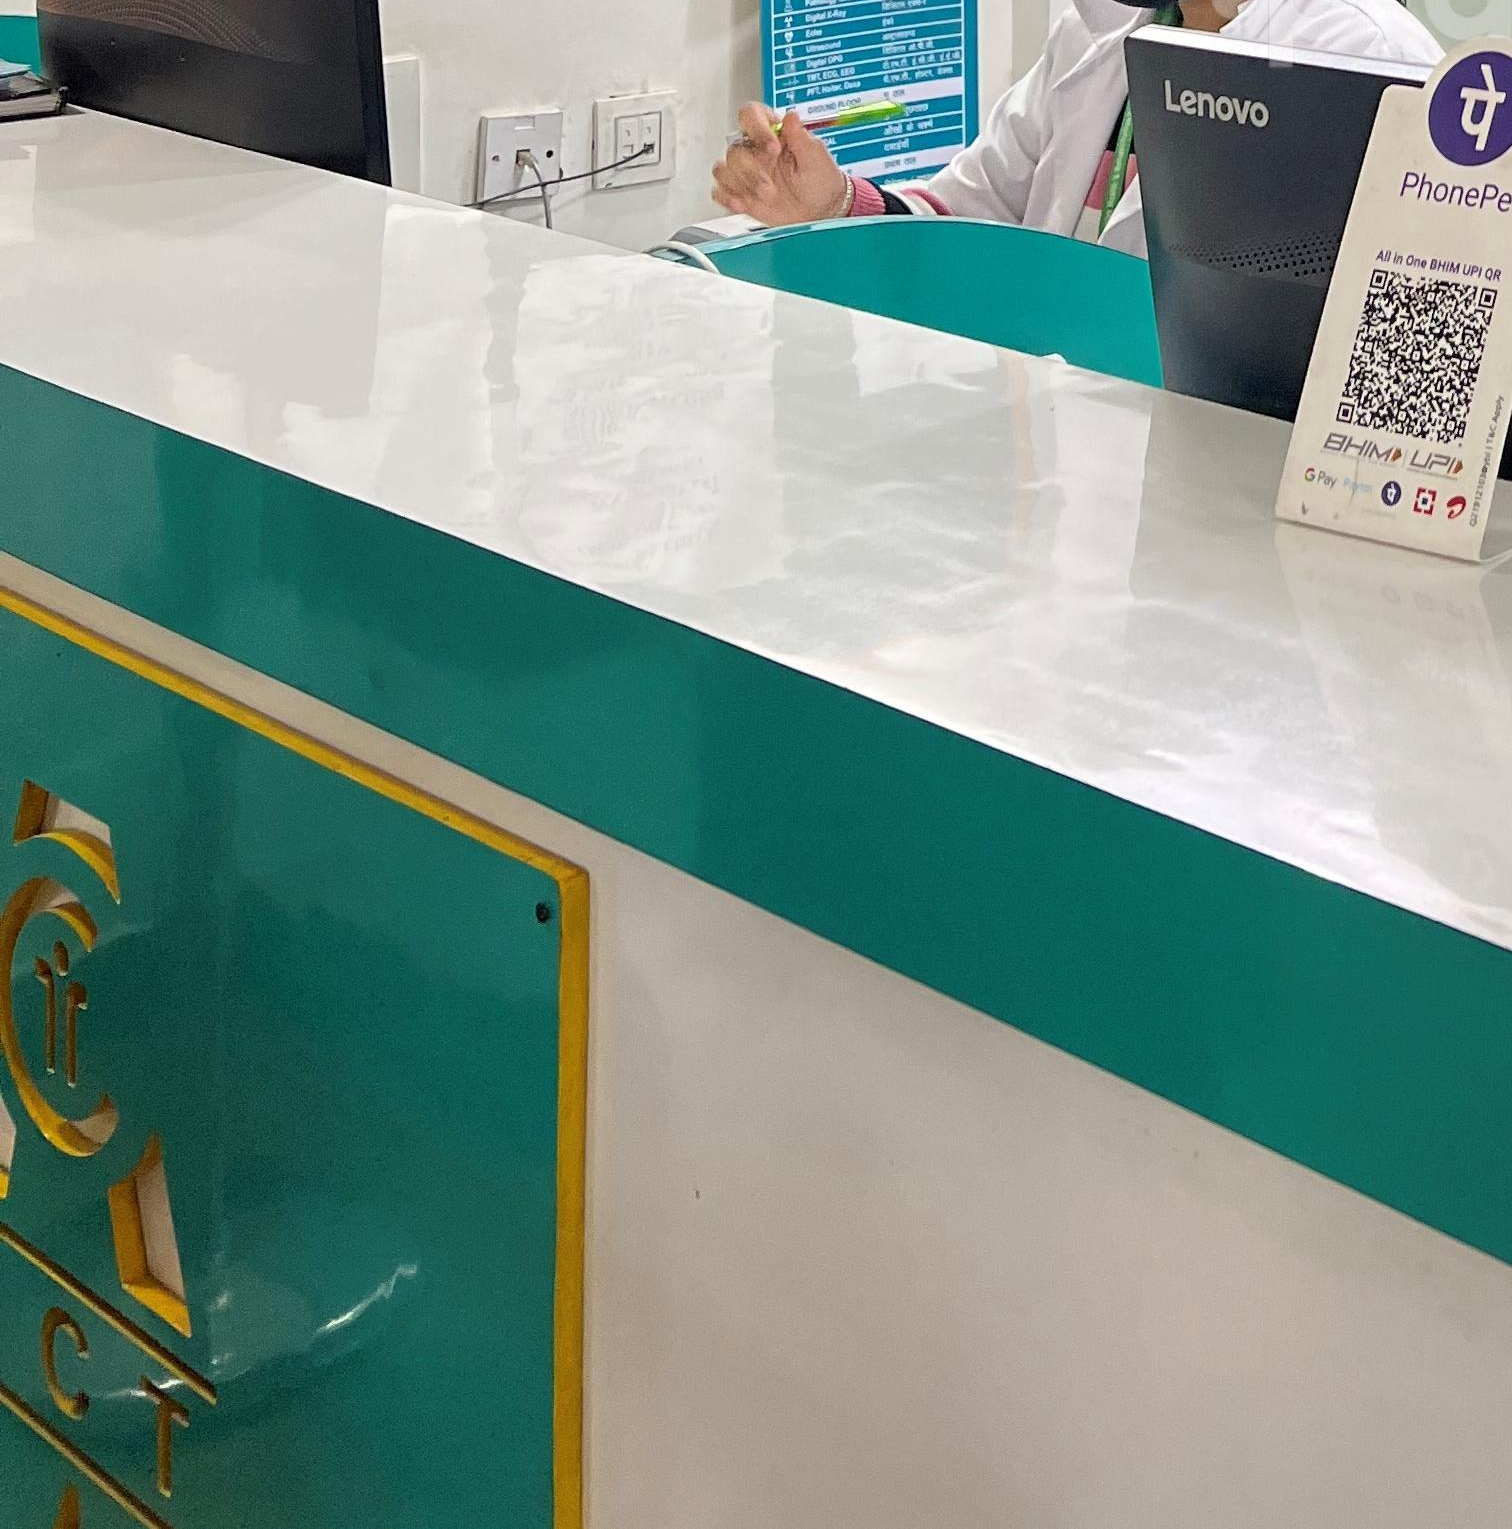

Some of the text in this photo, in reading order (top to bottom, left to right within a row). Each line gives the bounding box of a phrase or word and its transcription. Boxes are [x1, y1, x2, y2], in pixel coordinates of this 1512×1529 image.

[805, 11, 827, 24] Digital
[808, 102, 837, 115] GROUND
[1163, 79, 1269, 128] Lenovo
[1459, 64, 1506, 151] पे
[1400, 171, 1512, 212] PhonePe
[1376, 249, 1391, 262] All
[1406, 255, 1427, 268] One
[1430, 258, 1461, 274] BHIM
[1462, 263, 1482, 279] UPI
[1484, 268, 1501, 282] QR
[1324, 432, 1457, 475] BHIM UPI
[1317, 470, 1338, 490] Pay
